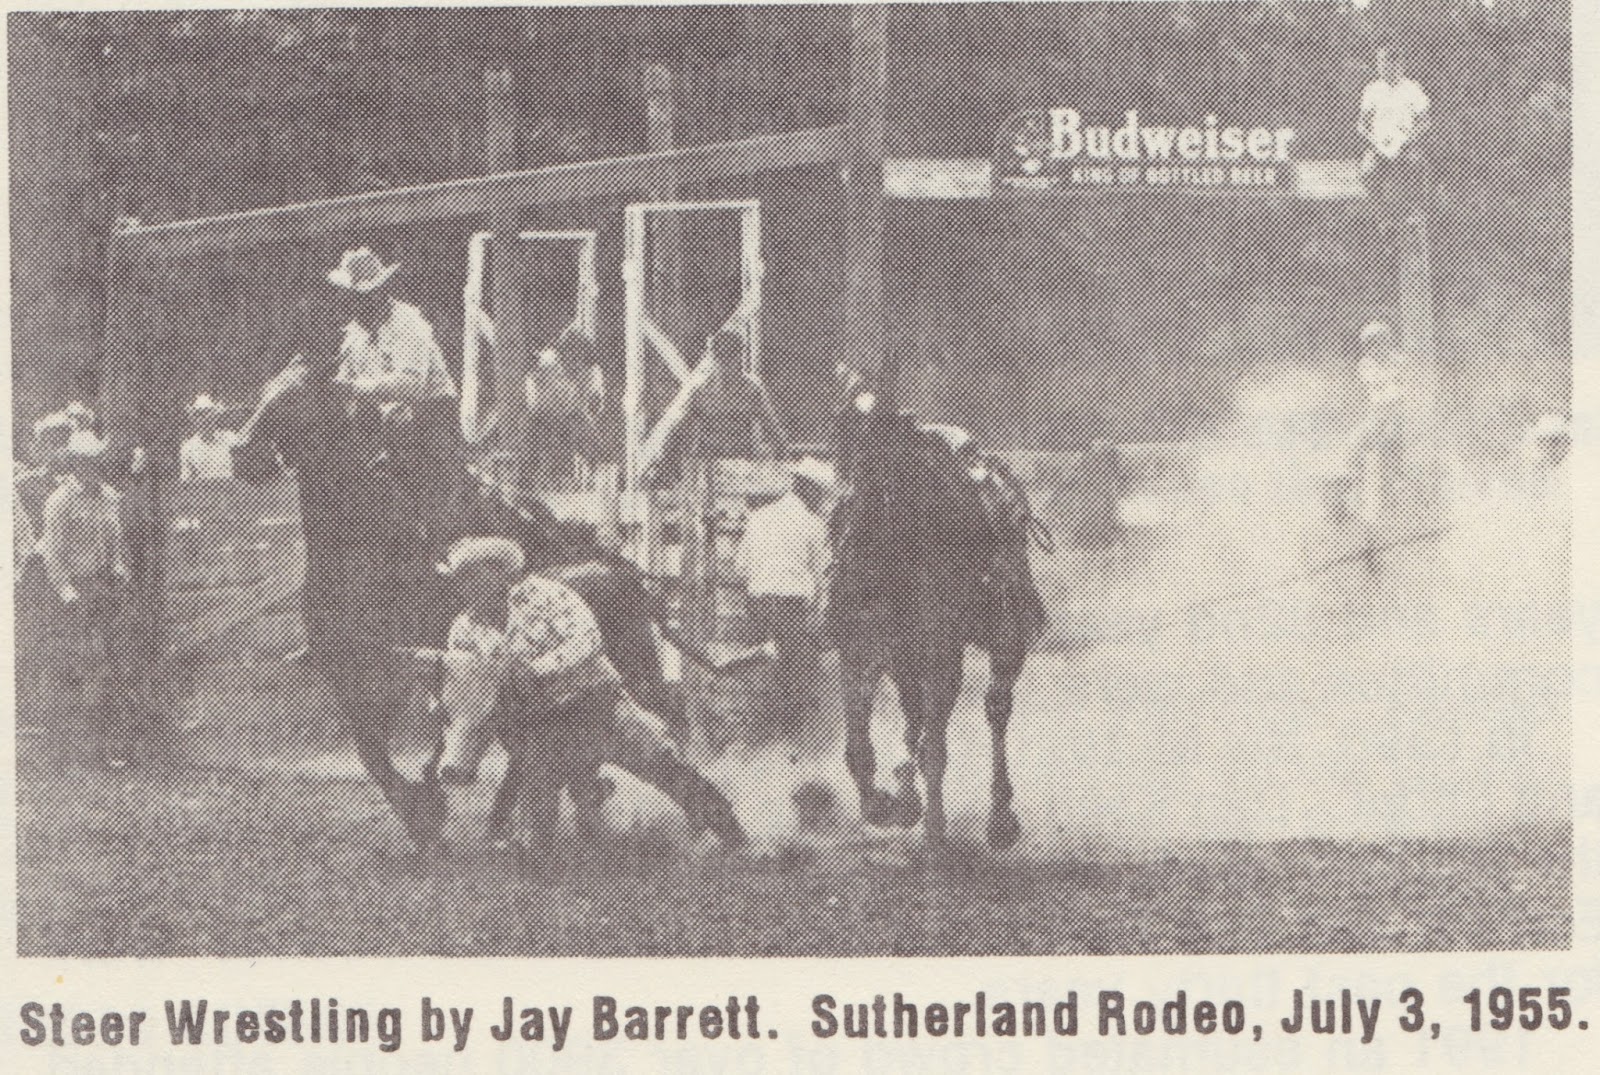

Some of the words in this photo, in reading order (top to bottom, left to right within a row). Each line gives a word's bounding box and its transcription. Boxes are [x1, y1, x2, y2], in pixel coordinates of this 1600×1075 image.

[1049, 107, 1296, 160] Budweiser
[1071, 167, 1113, 184] KING
[1118, 167, 1140, 184] OF
[1145, 167, 1224, 185] BOTTLED
[1230, 167, 1276, 184] BEER
